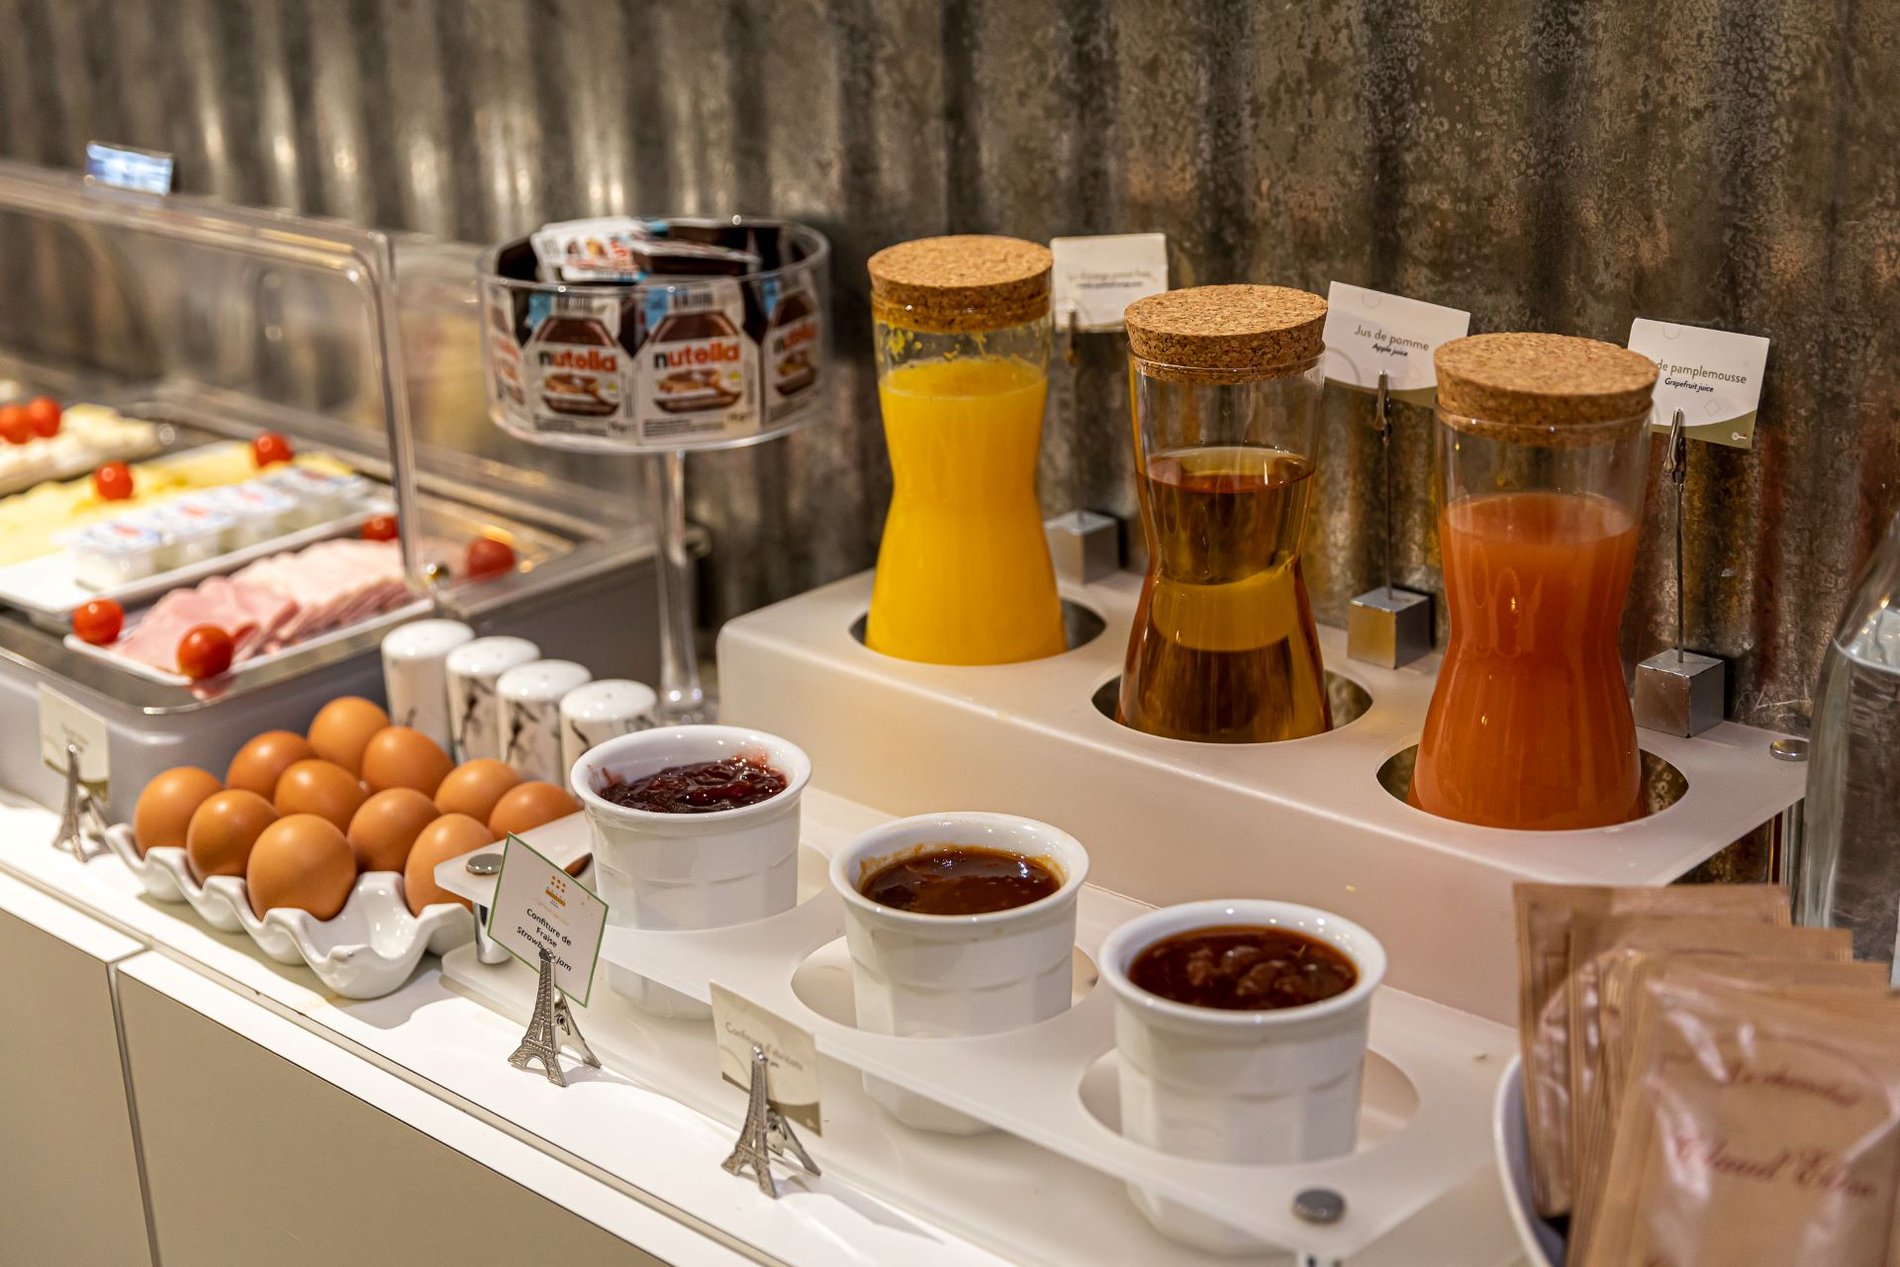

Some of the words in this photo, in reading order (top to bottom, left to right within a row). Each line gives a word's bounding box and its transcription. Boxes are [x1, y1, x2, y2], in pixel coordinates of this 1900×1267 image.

[1354, 324, 1371, 338] Jus
[1374, 329, 1387, 341] de
[1389, 336, 1429, 351] pomme
[1372, 342, 1391, 353] Apple
[538, 347, 617, 372] nutella
[654, 342, 740, 369] nutella
[1656, 358, 1668, 371] de
[1670, 365, 1747, 384] pamplemousse
[1664, 377, 1698, 390] Grapefruit
[1696, 382, 1714, 392] juice
[526, 908, 561, 938] Confiture
[561, 935, 572, 946] de
[536, 926, 557, 948] Fraise
[556, 956, 572, 971] jam
